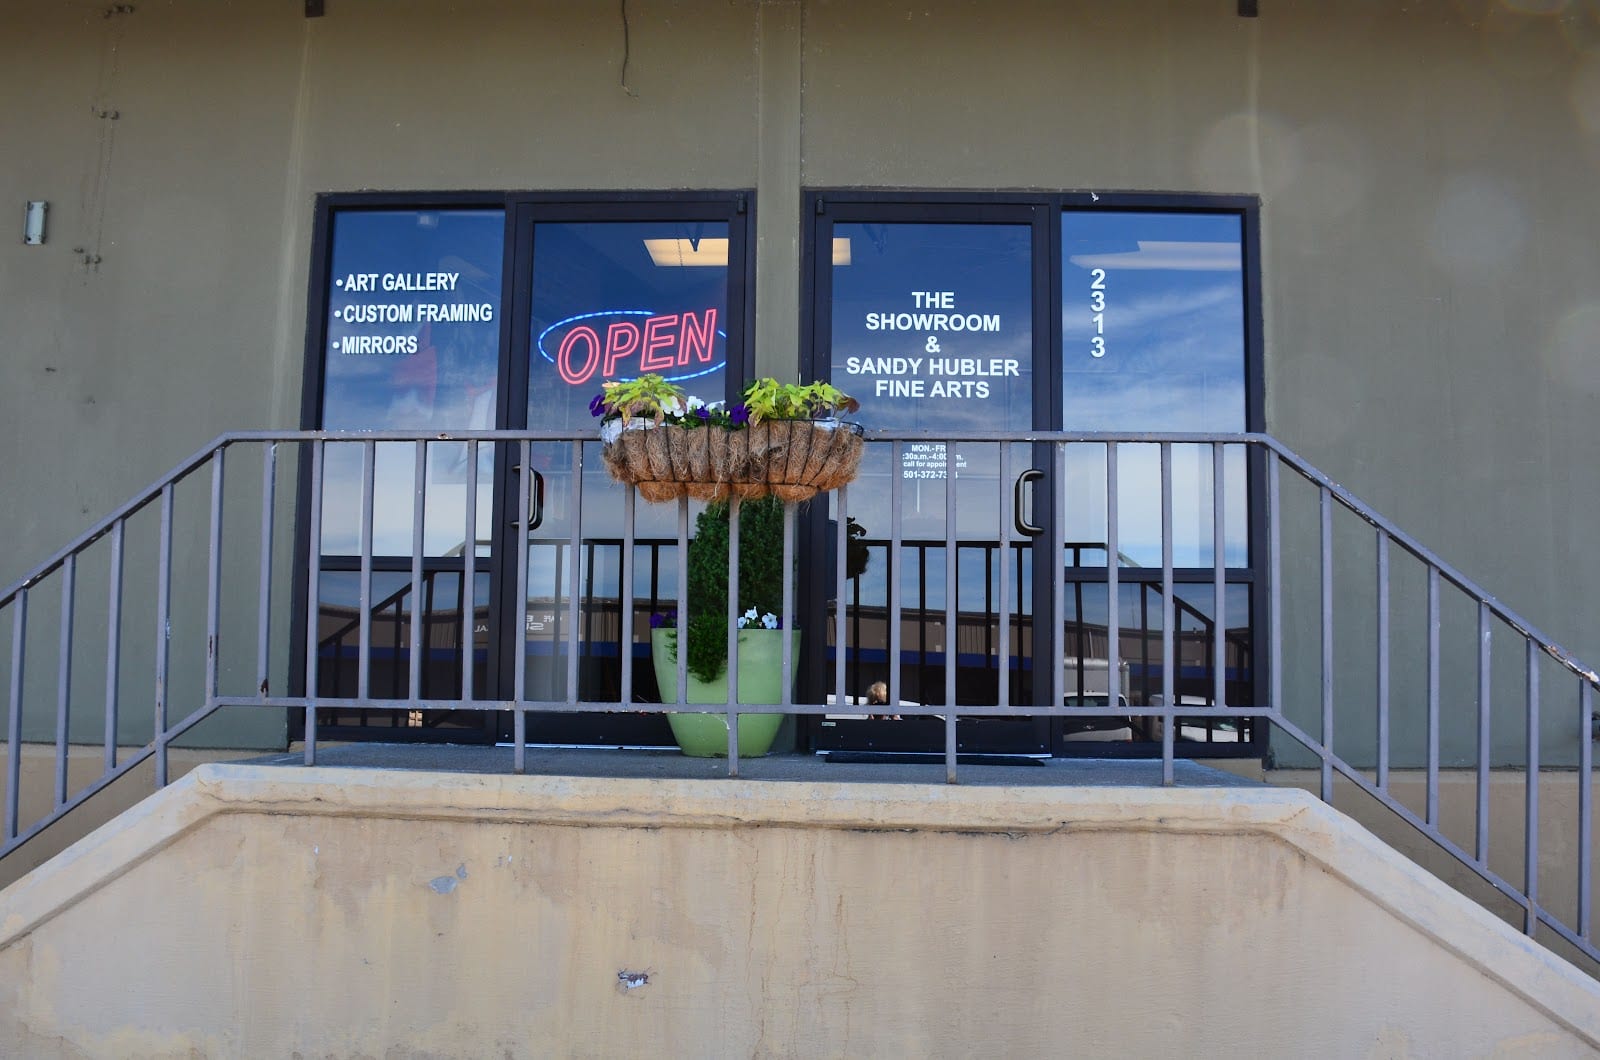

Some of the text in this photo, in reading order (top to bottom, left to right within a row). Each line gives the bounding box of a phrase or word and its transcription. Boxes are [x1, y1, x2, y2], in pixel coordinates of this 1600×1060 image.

[344, 272, 459, 292] ART GALLERY
[911, 291, 955, 309] THE
[343, 303, 493, 323] CUSTOM FRAMING
[865, 312, 1001, 332] SHOWROOM
[1090, 268, 1106, 358] 2313
[341, 335, 418, 354] MIRRORS
[557, 308, 717, 385] OPEN
[925, 335, 941, 353] &
[846, 356, 1020, 377] SANDY HUBLER
[875, 379, 990, 399] FINE ARTS
